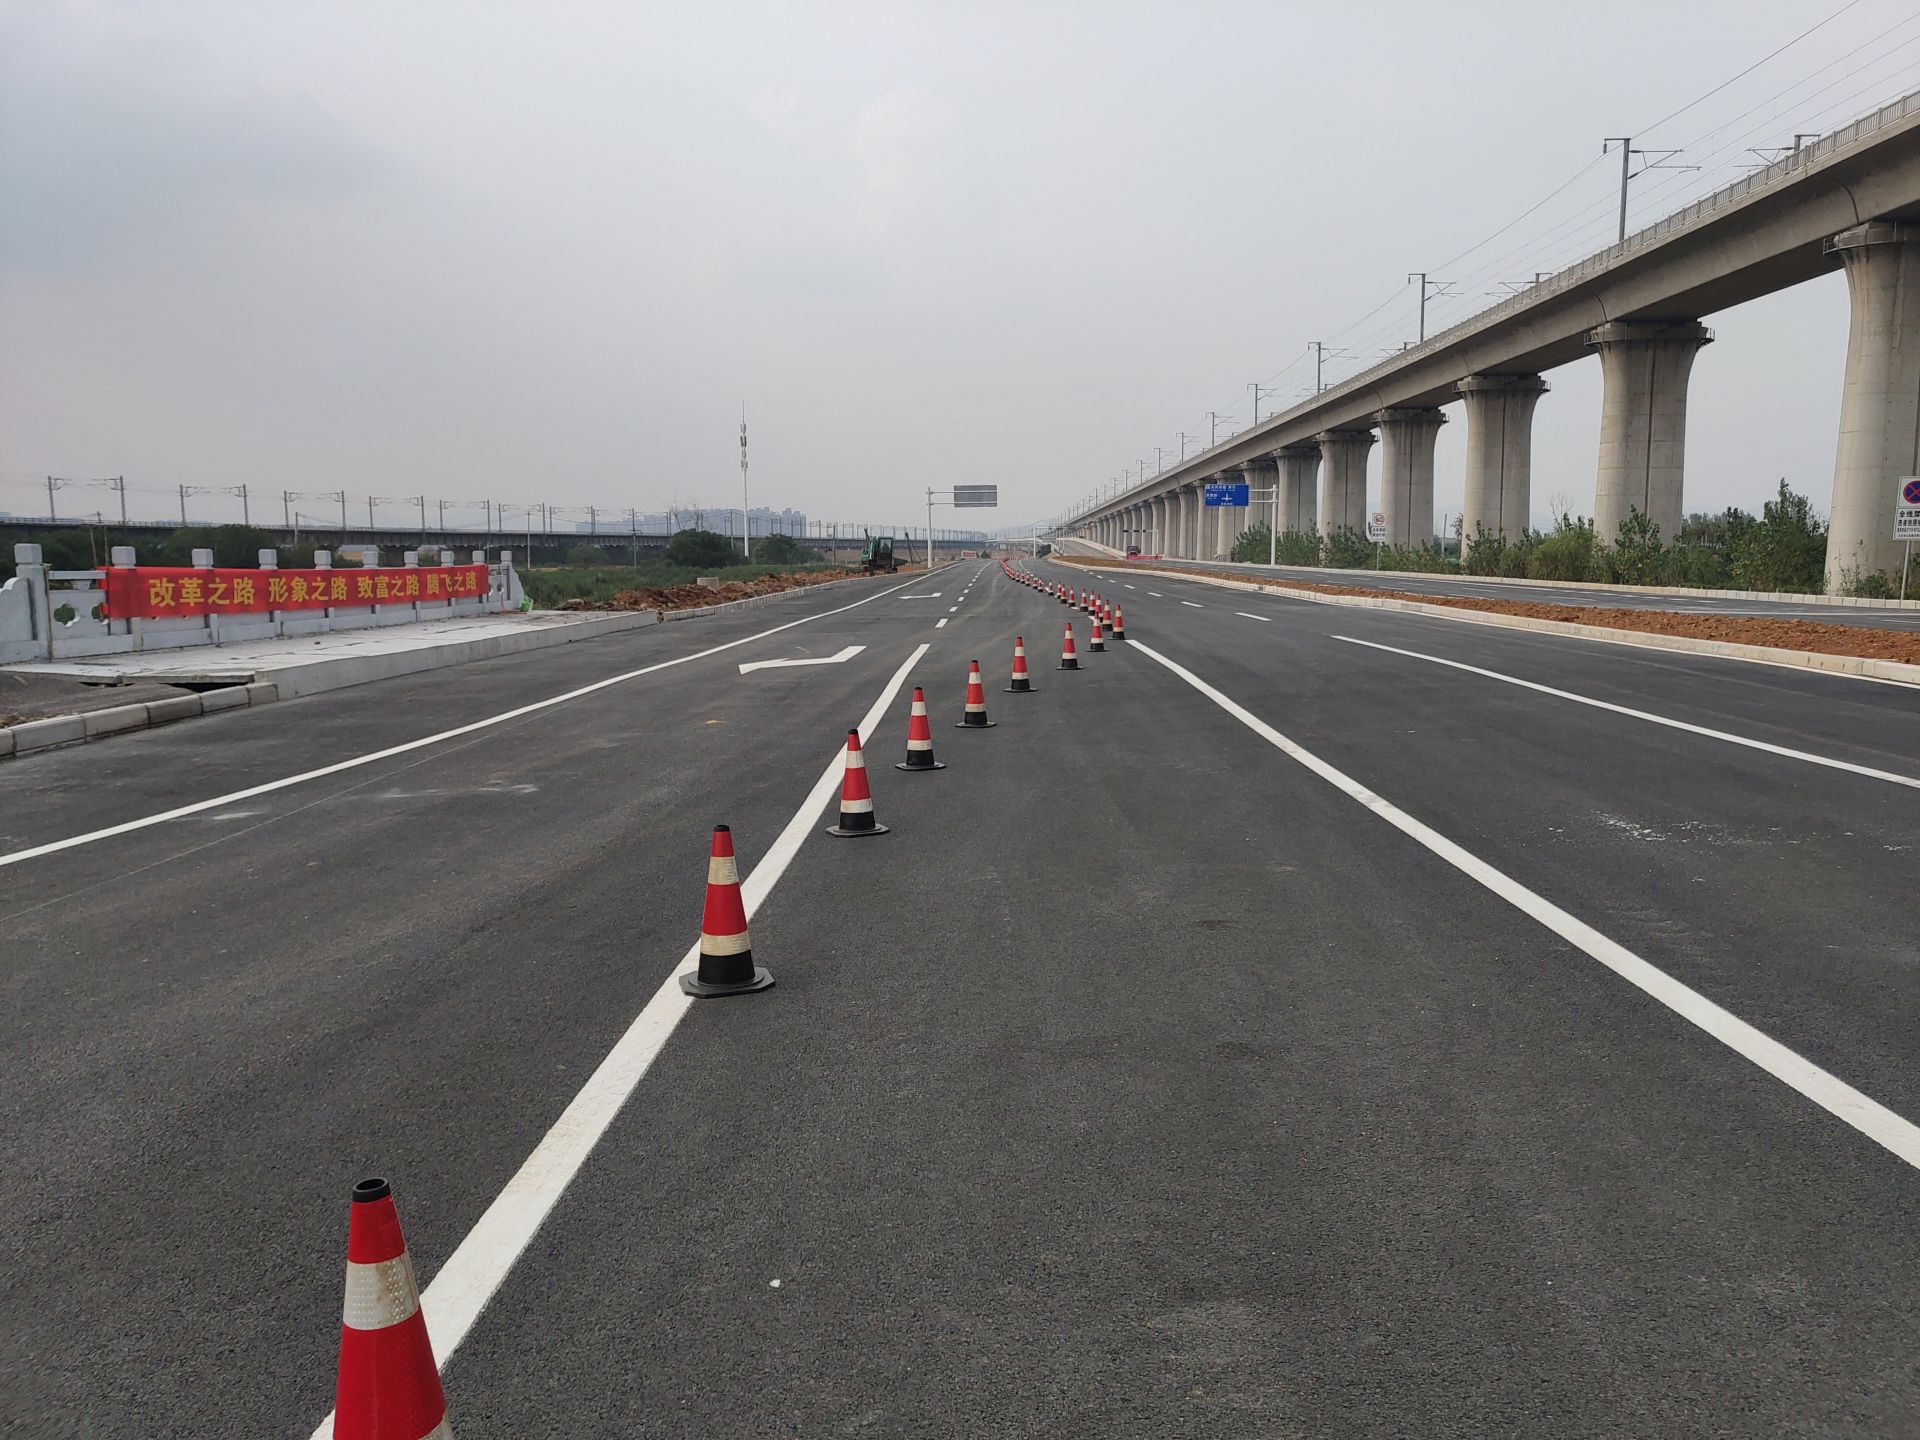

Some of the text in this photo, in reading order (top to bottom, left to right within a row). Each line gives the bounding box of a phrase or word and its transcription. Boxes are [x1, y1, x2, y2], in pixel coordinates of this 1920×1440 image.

[148, 571, 477, 607] 改革之路 形象之路 致富之路 腾飞之路
